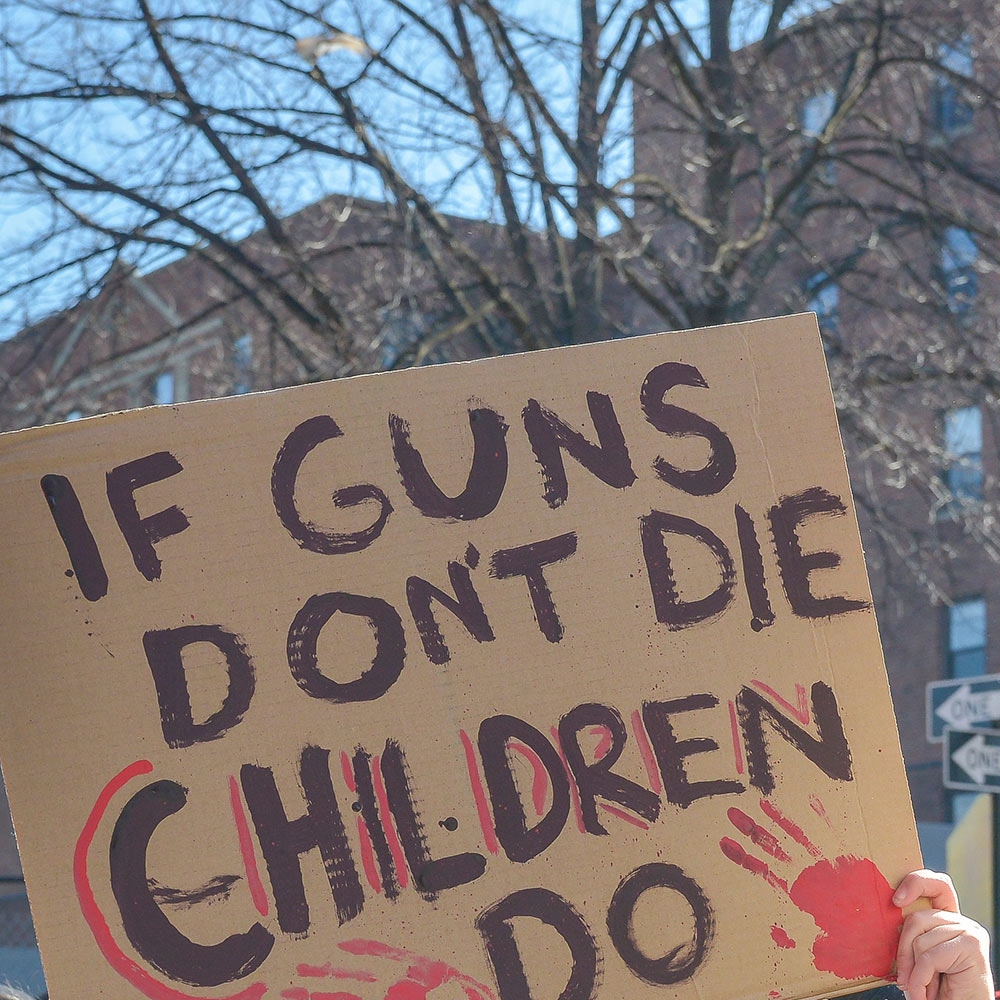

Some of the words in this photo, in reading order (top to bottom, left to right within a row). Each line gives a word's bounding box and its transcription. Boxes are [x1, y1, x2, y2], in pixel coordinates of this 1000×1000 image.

[41, 451, 191, 601] IF
[270, 362, 737, 555] GUNS
[142, 531, 578, 748] DON'T
[637, 486, 871, 632] DIE
[950, 699, 989, 719] ONE
[108, 682, 854, 986] CHILDREN
[965, 746, 1000, 769] ONE
